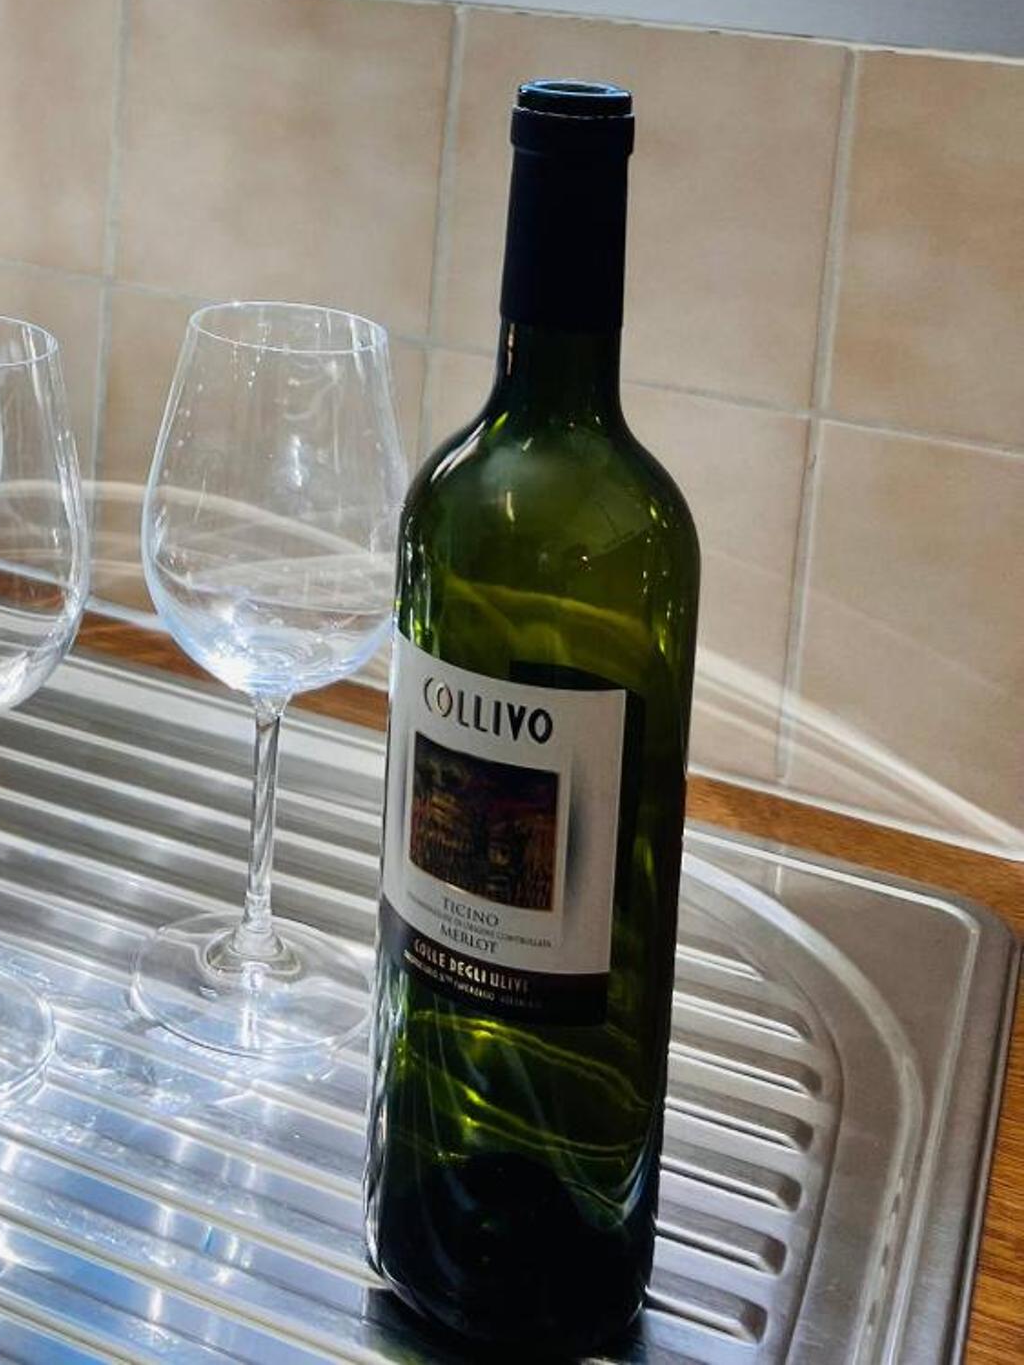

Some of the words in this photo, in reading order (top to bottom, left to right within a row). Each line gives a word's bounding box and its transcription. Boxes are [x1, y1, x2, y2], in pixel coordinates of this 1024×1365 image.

[423, 676, 554, 745] COLLIVO
[442, 897, 499, 927] TICINO
[440, 923, 497, 953] MERLOT
[449, 957, 487, 983] DEGLI
